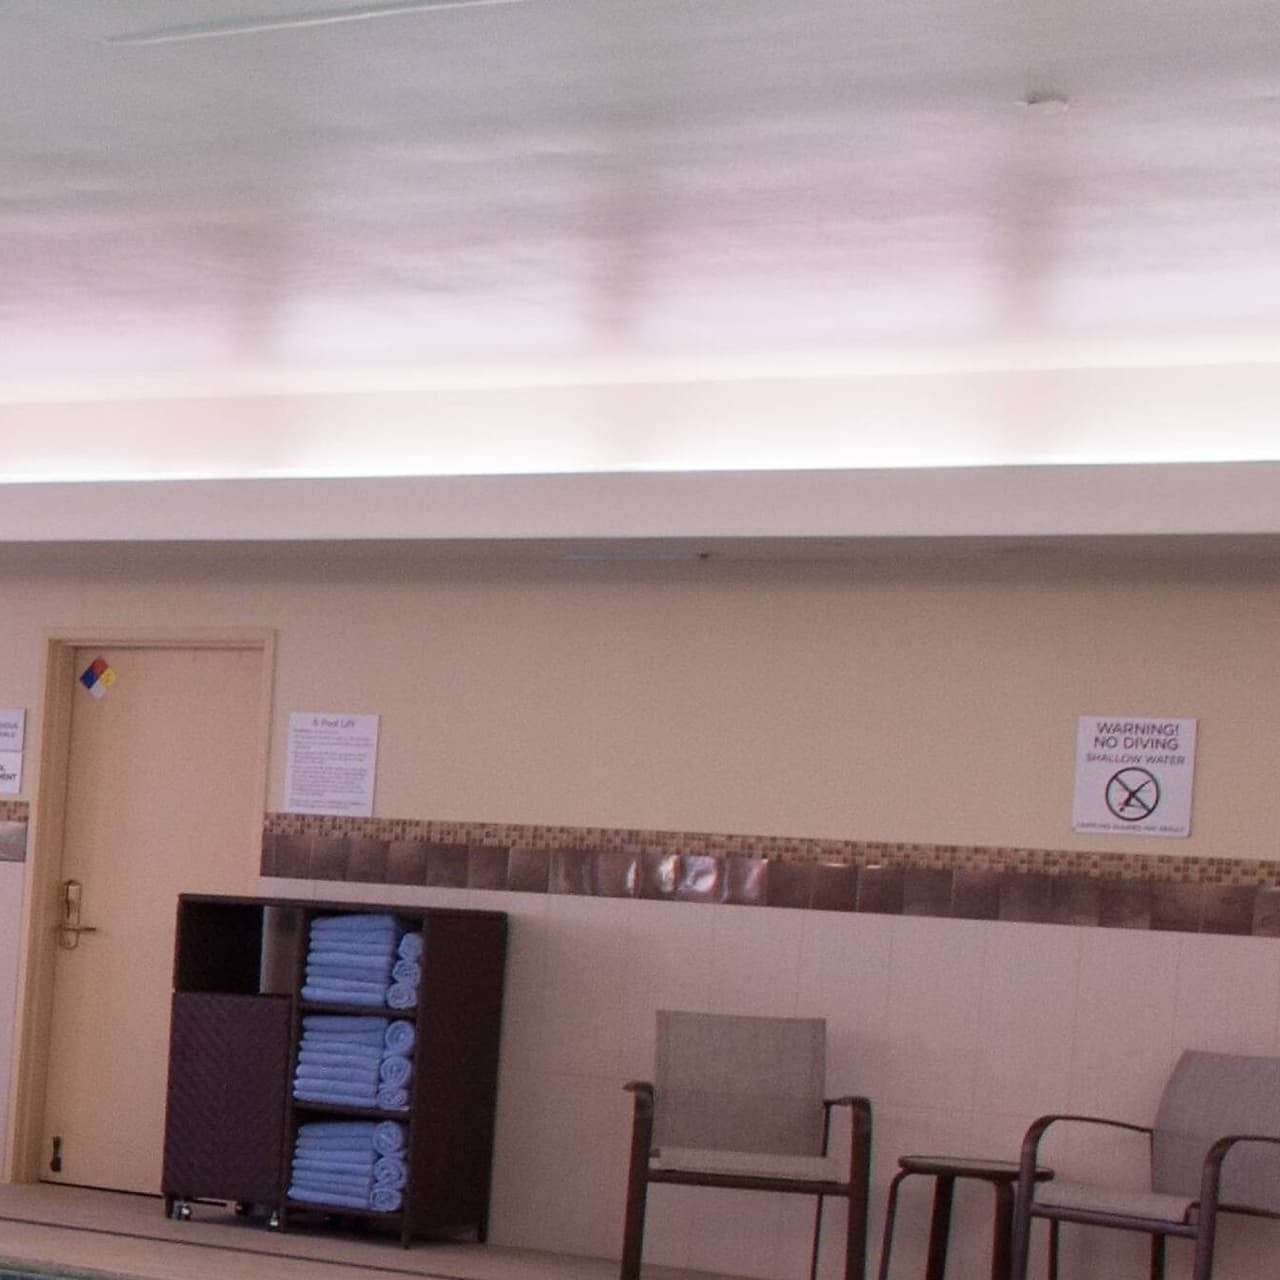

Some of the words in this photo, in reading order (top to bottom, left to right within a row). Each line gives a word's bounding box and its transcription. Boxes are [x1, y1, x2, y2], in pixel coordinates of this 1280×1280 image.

[1094, 737, 1118, 749] NO
[1123, 738, 1179, 751] DIVING
[1086, 752, 1142, 764] SHALLOW
[1146, 754, 1185, 765] WATER
